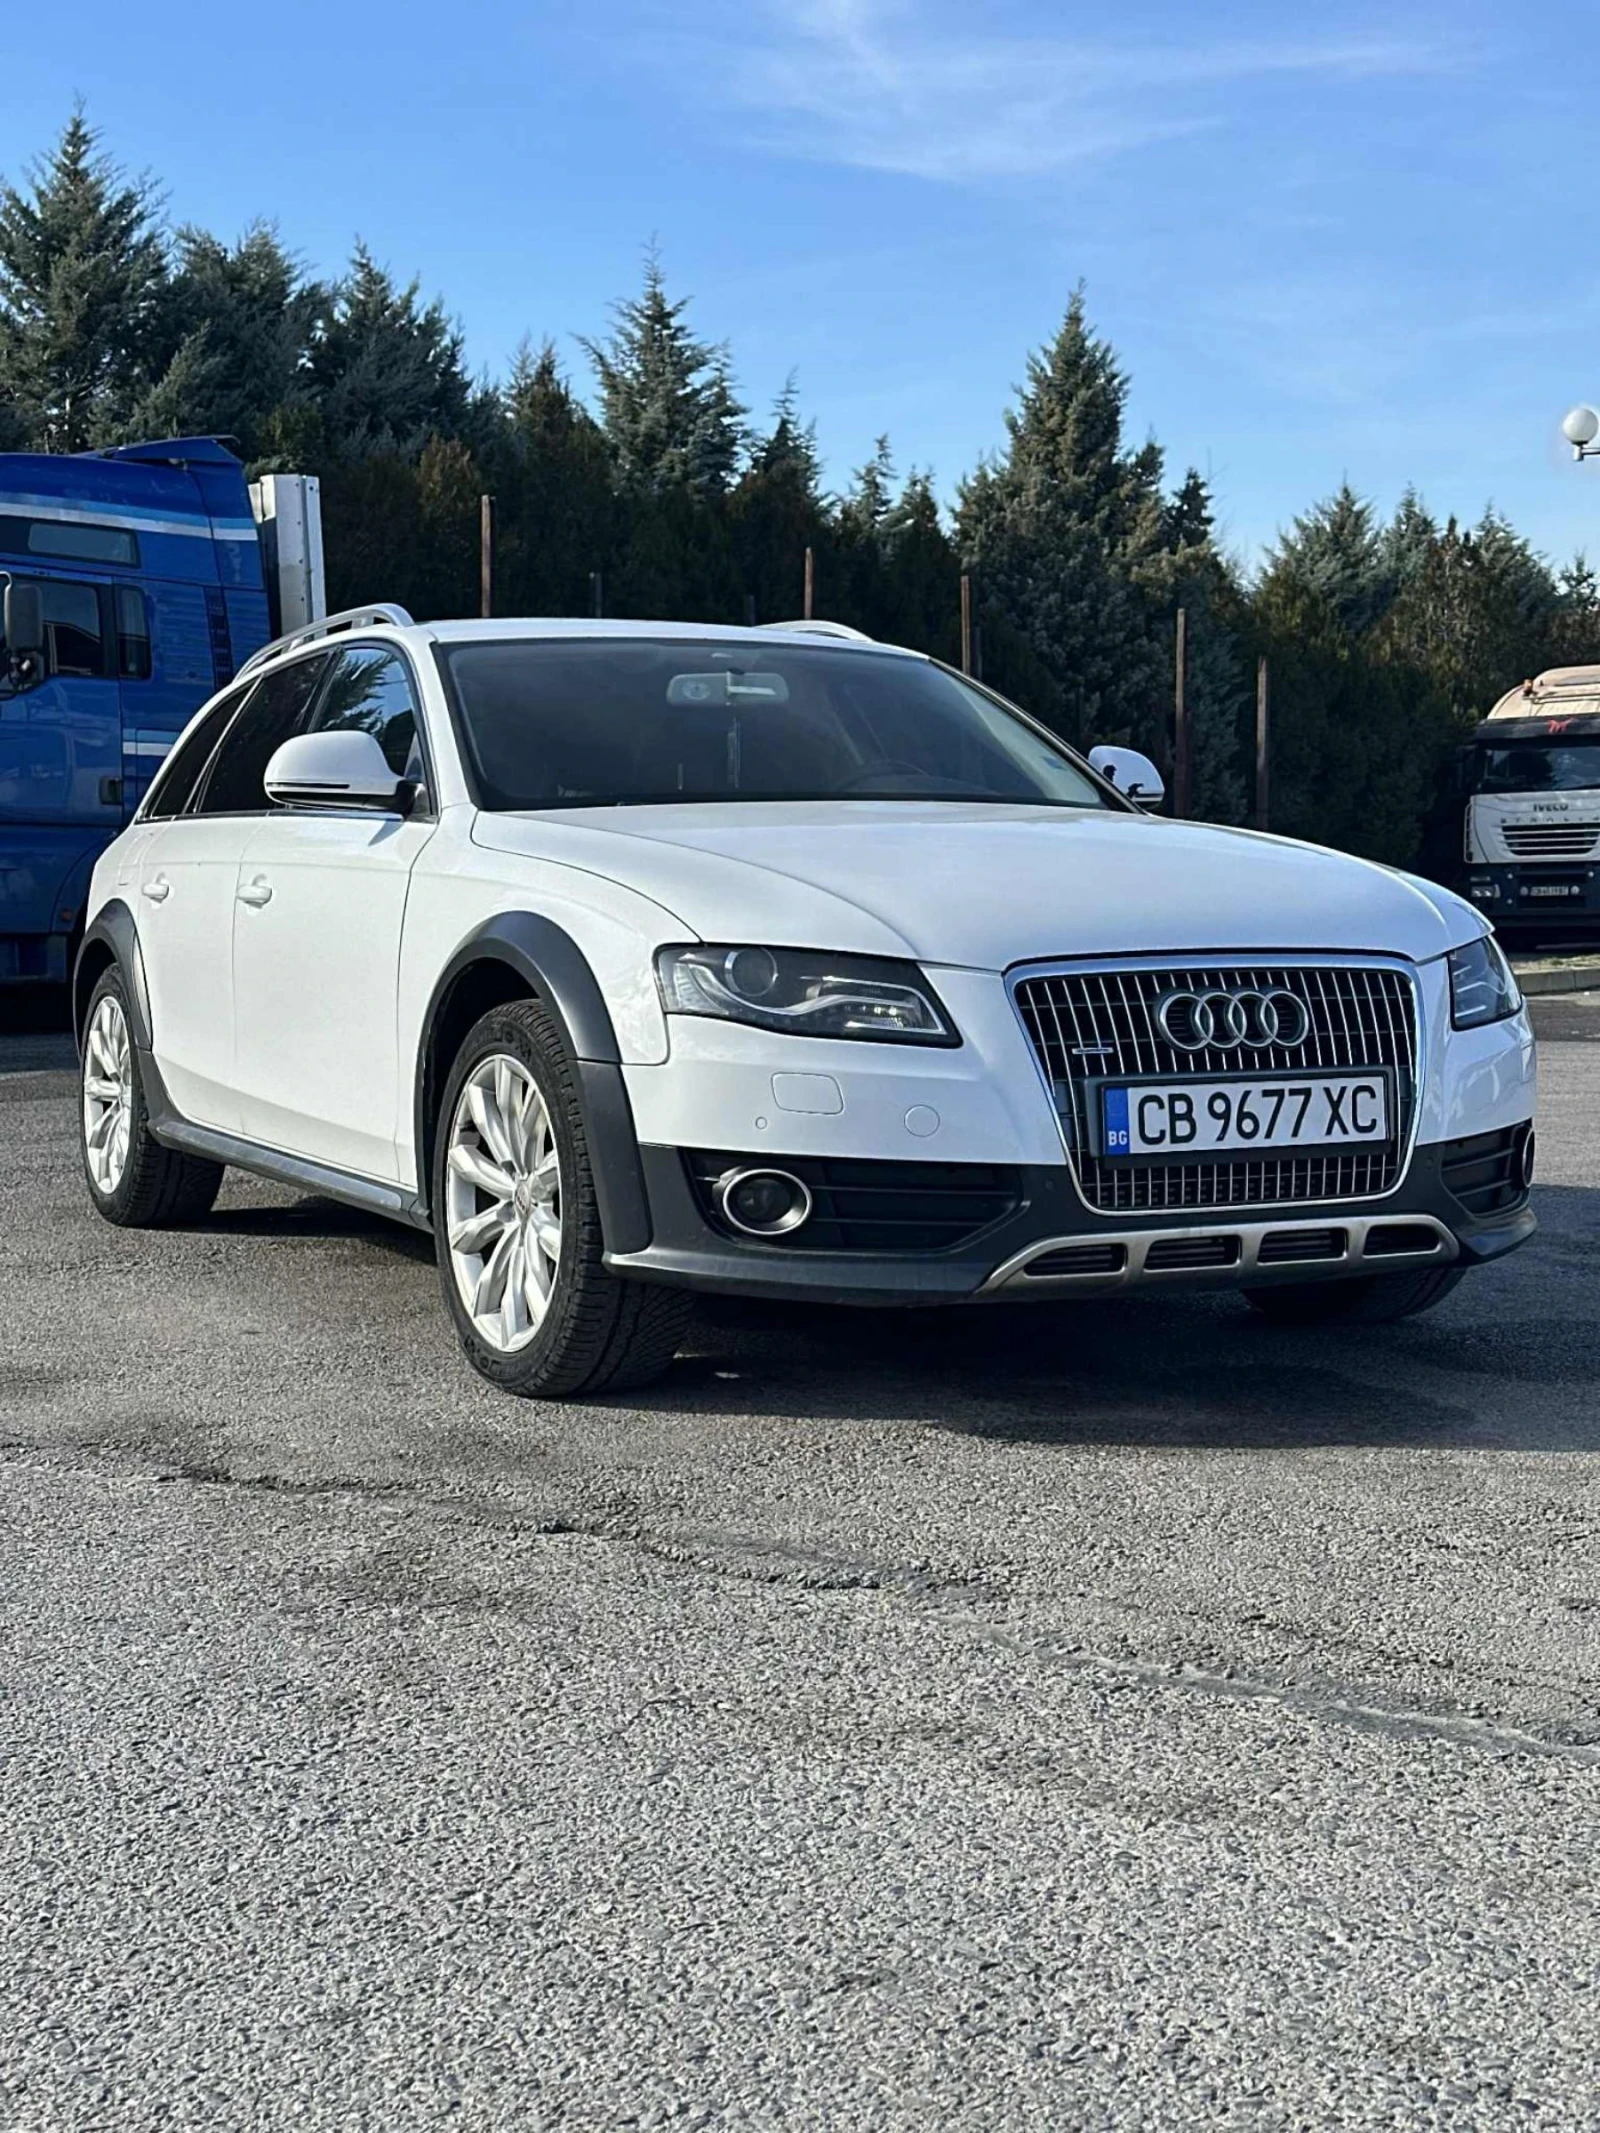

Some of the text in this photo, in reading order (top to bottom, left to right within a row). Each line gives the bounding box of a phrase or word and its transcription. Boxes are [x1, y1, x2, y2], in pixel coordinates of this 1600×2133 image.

[1533, 803, 1569, 812] IVECO
[1137, 1084, 1378, 1146] CB 9677 XC
[1108, 1130, 1128, 1146] BG
